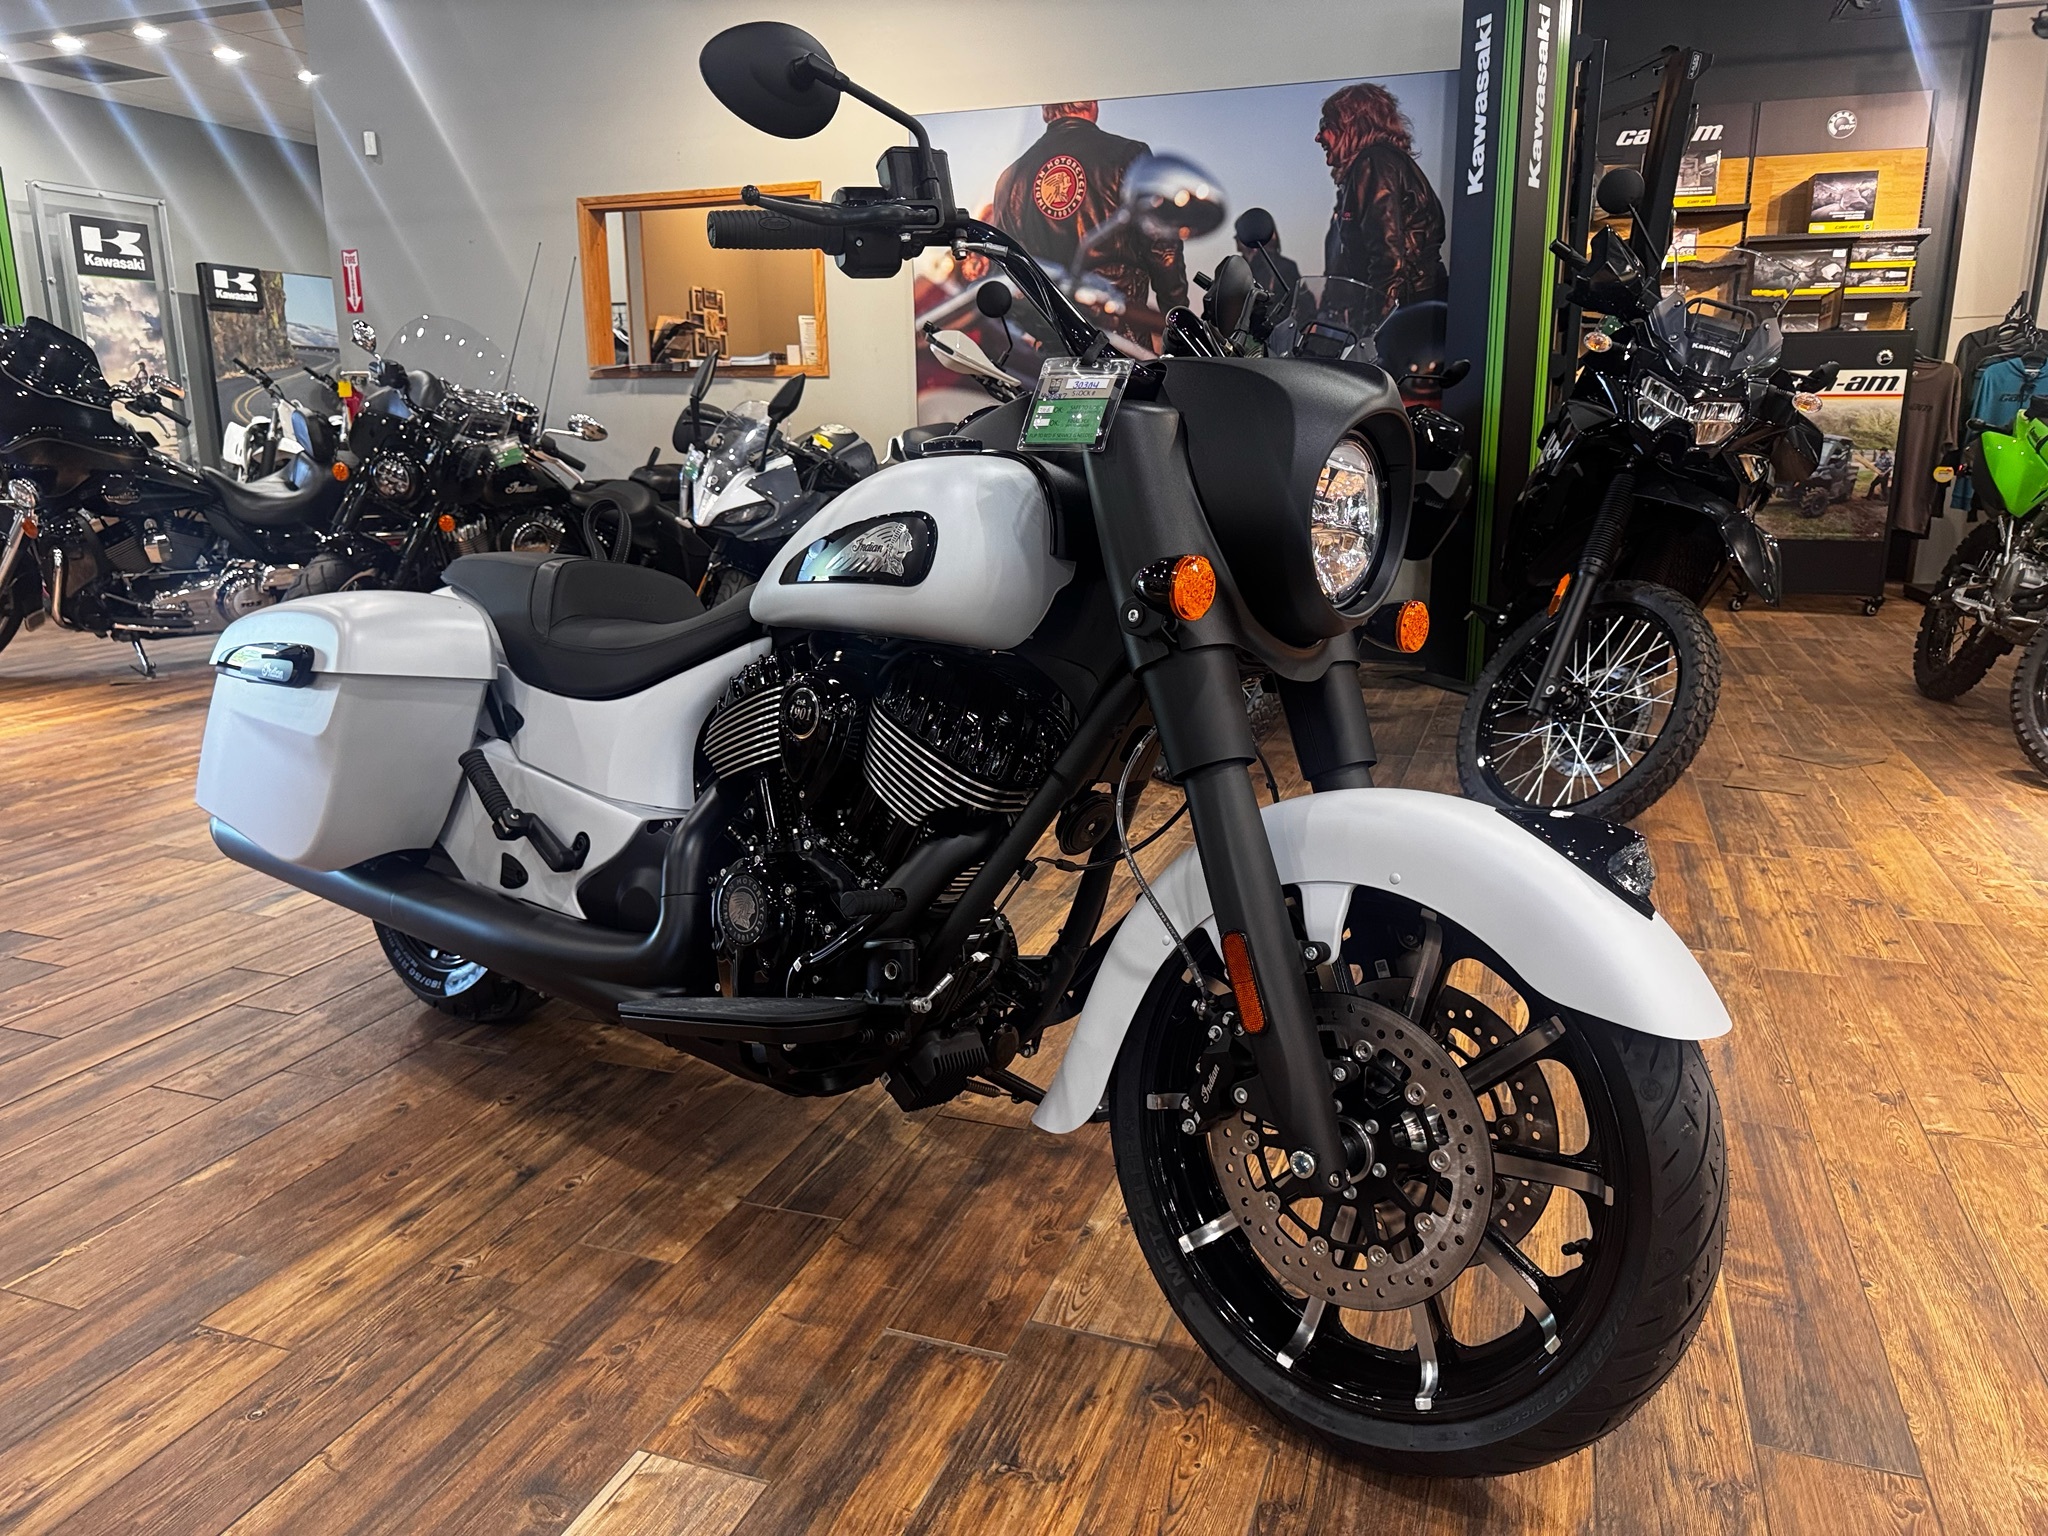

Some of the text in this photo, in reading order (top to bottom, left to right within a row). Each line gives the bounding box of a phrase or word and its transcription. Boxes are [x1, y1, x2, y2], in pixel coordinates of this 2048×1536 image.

[1467, 13, 1493, 195] Kawasaki
[1528, 3, 1551, 189] Kawasaki
[1047, 158, 1085, 201] MOTORCYCLE
[83, 252, 146, 271] Kawasaki
[215, 288, 258, 302] Kawasaki
[1691, 341, 1732, 359] Kawasaki
[852, 538, 884, 553] Indian
[261, 662, 284, 680] Indian
[1201, 1063, 1220, 1103] Indian
